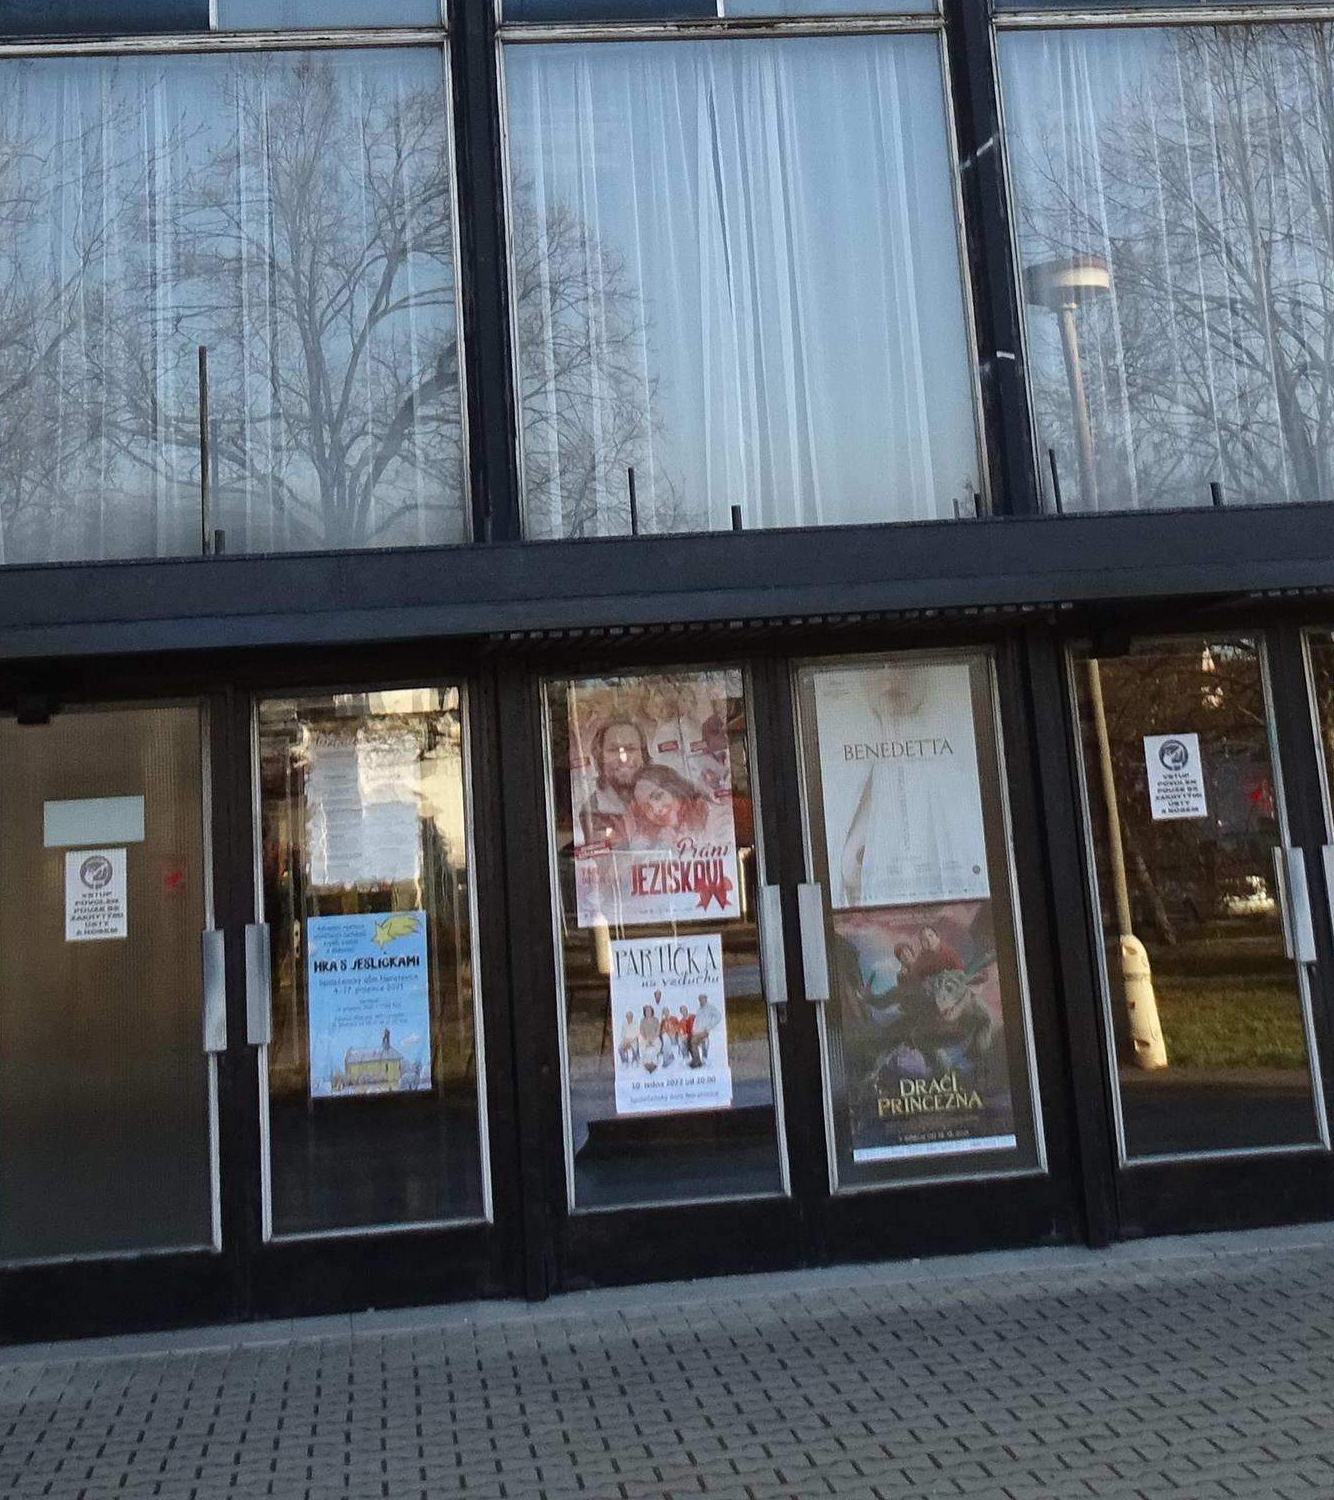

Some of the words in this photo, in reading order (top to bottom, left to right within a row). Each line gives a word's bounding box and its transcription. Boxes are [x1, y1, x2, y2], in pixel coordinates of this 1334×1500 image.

[843, 738, 954, 761] BENEDETTA
[314, 961, 338, 973] HRA
[616, 944, 717, 979] PARTIČKA
[877, 1090, 983, 1118] PRINCEZNA
